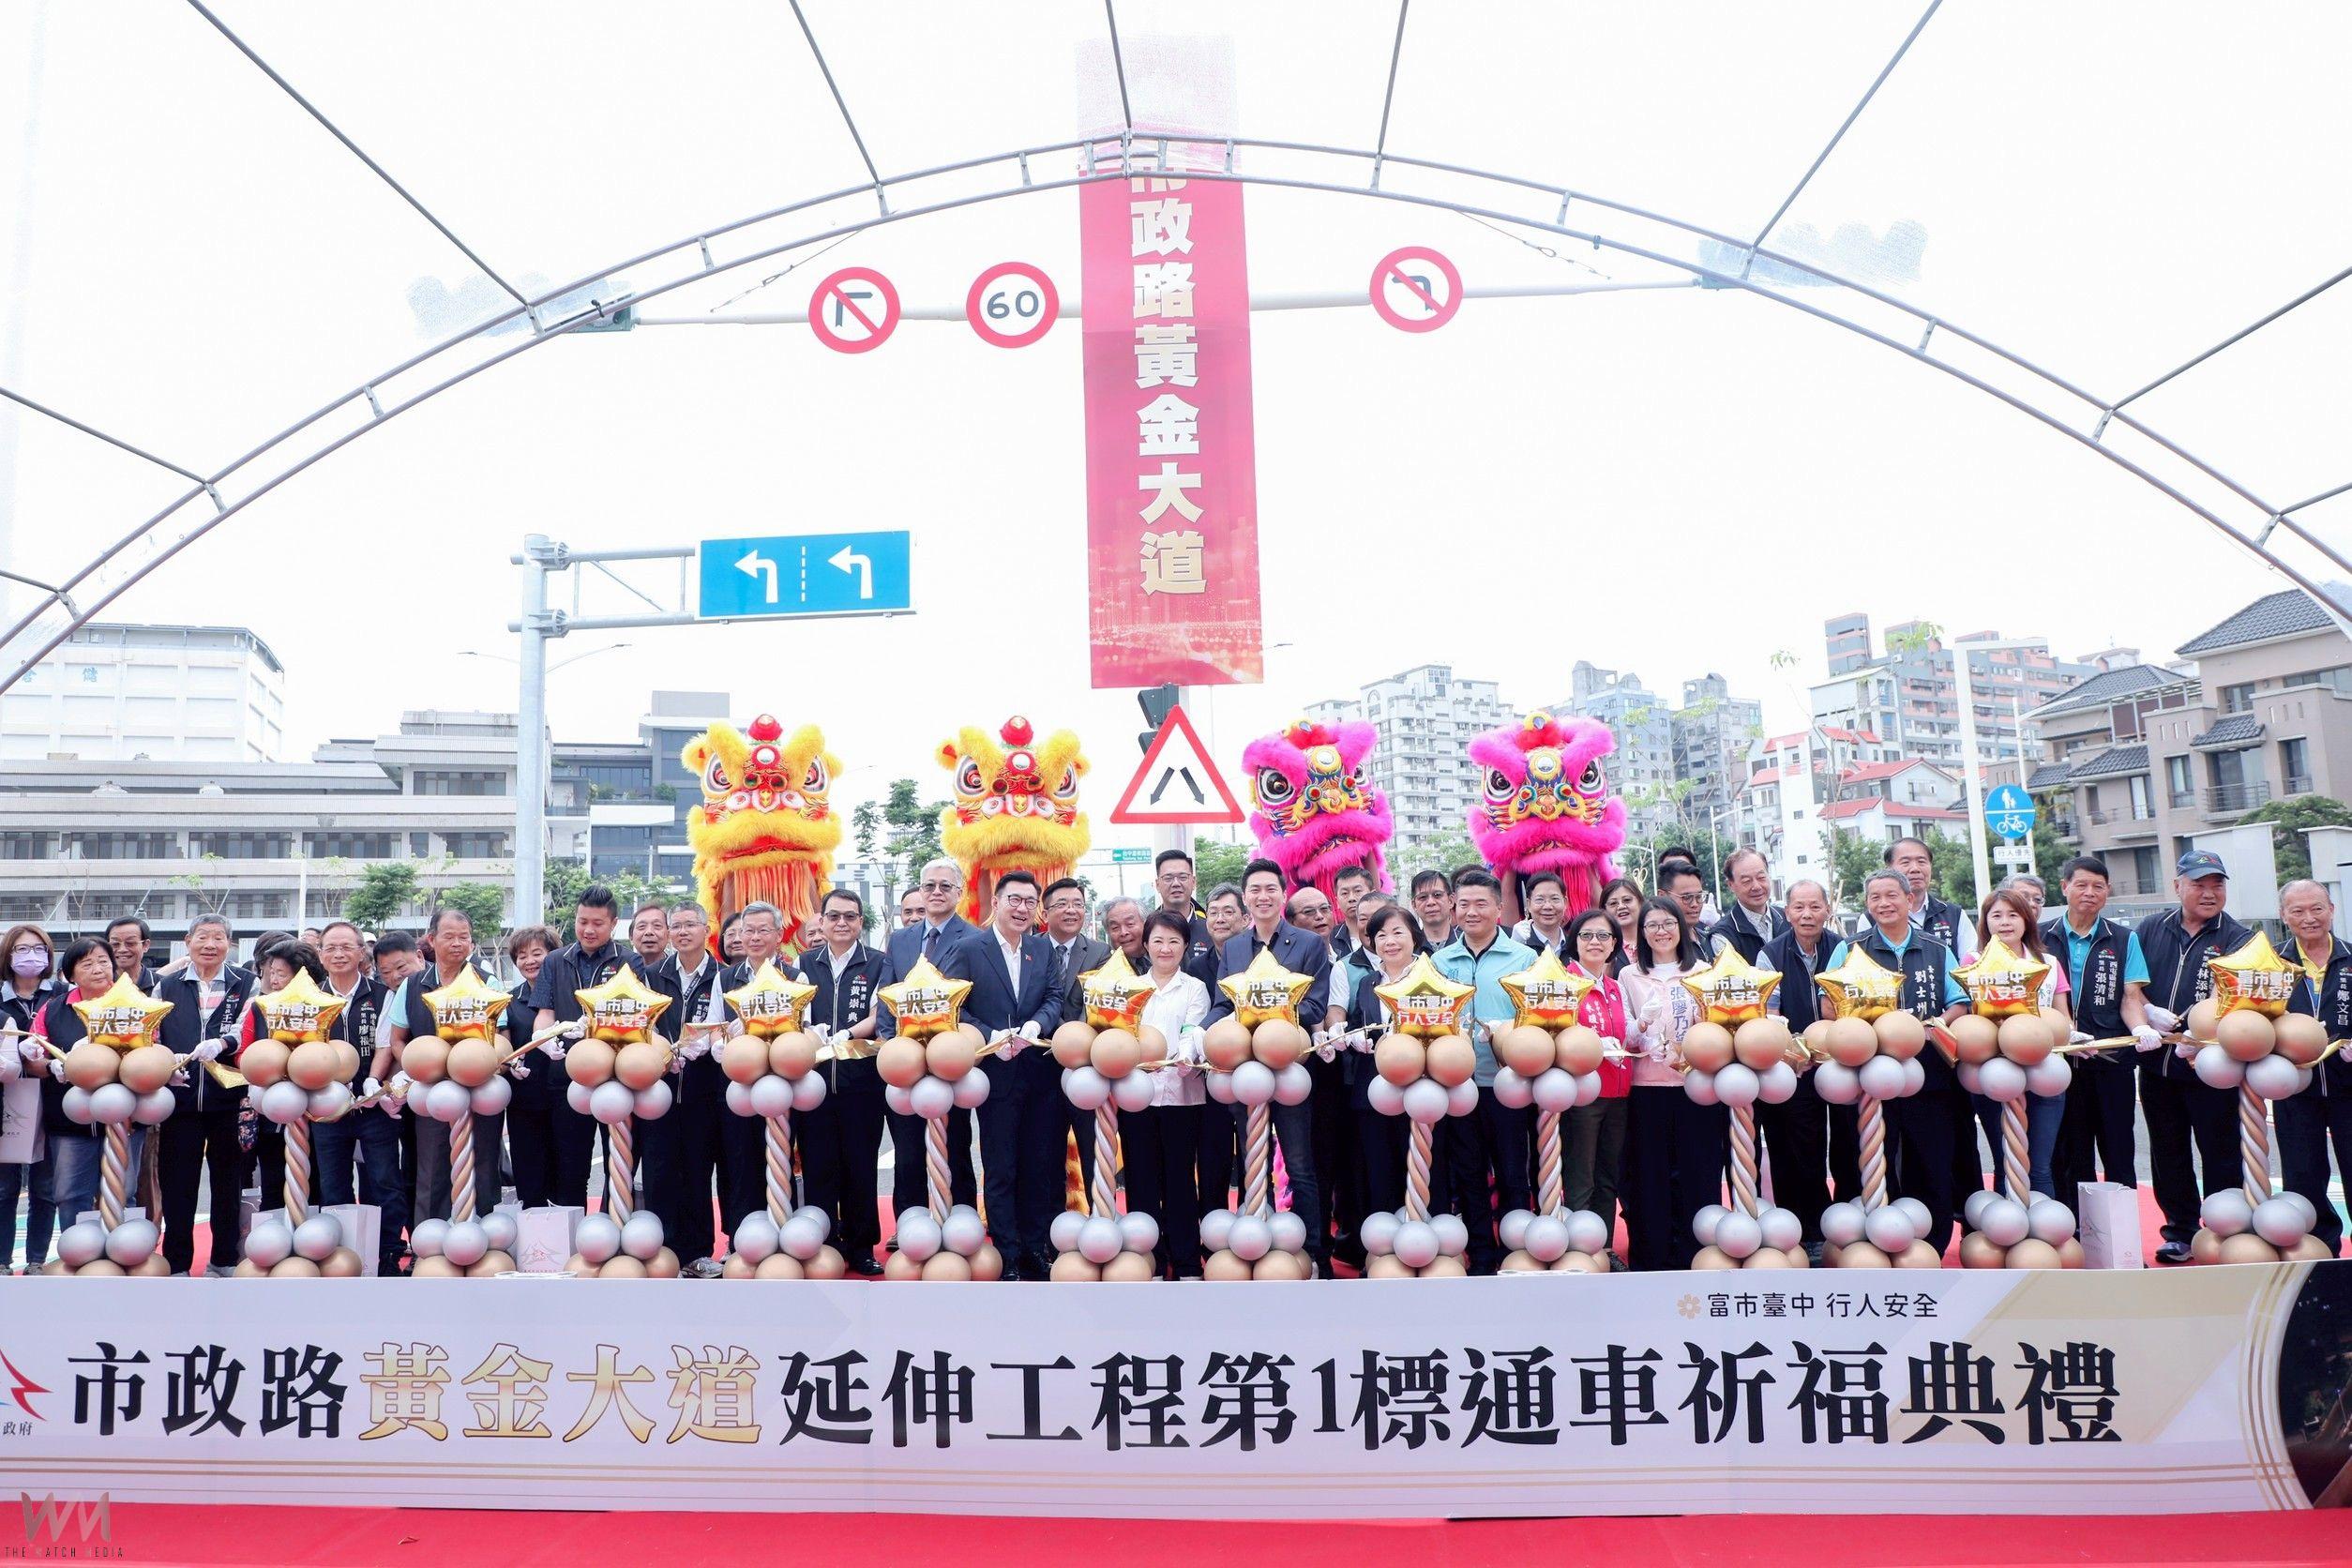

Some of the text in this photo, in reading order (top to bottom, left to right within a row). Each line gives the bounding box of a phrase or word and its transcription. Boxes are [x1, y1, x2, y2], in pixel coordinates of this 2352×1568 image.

[988, 291, 1038, 319] 60
[848, 986, 860, 1023] 黃崇典
[1914, 970, 1927, 1015] 劉士州
[2093, 972, 2106, 1006] 張清和
[1707, 1292, 1938, 1319] 富市臺中 行人安全
[68, 1341, 2121, 1451] 市政路黃金大道延伸工程第1標通車祈福典禮
[2, 1422, 33, 1437] 政府
